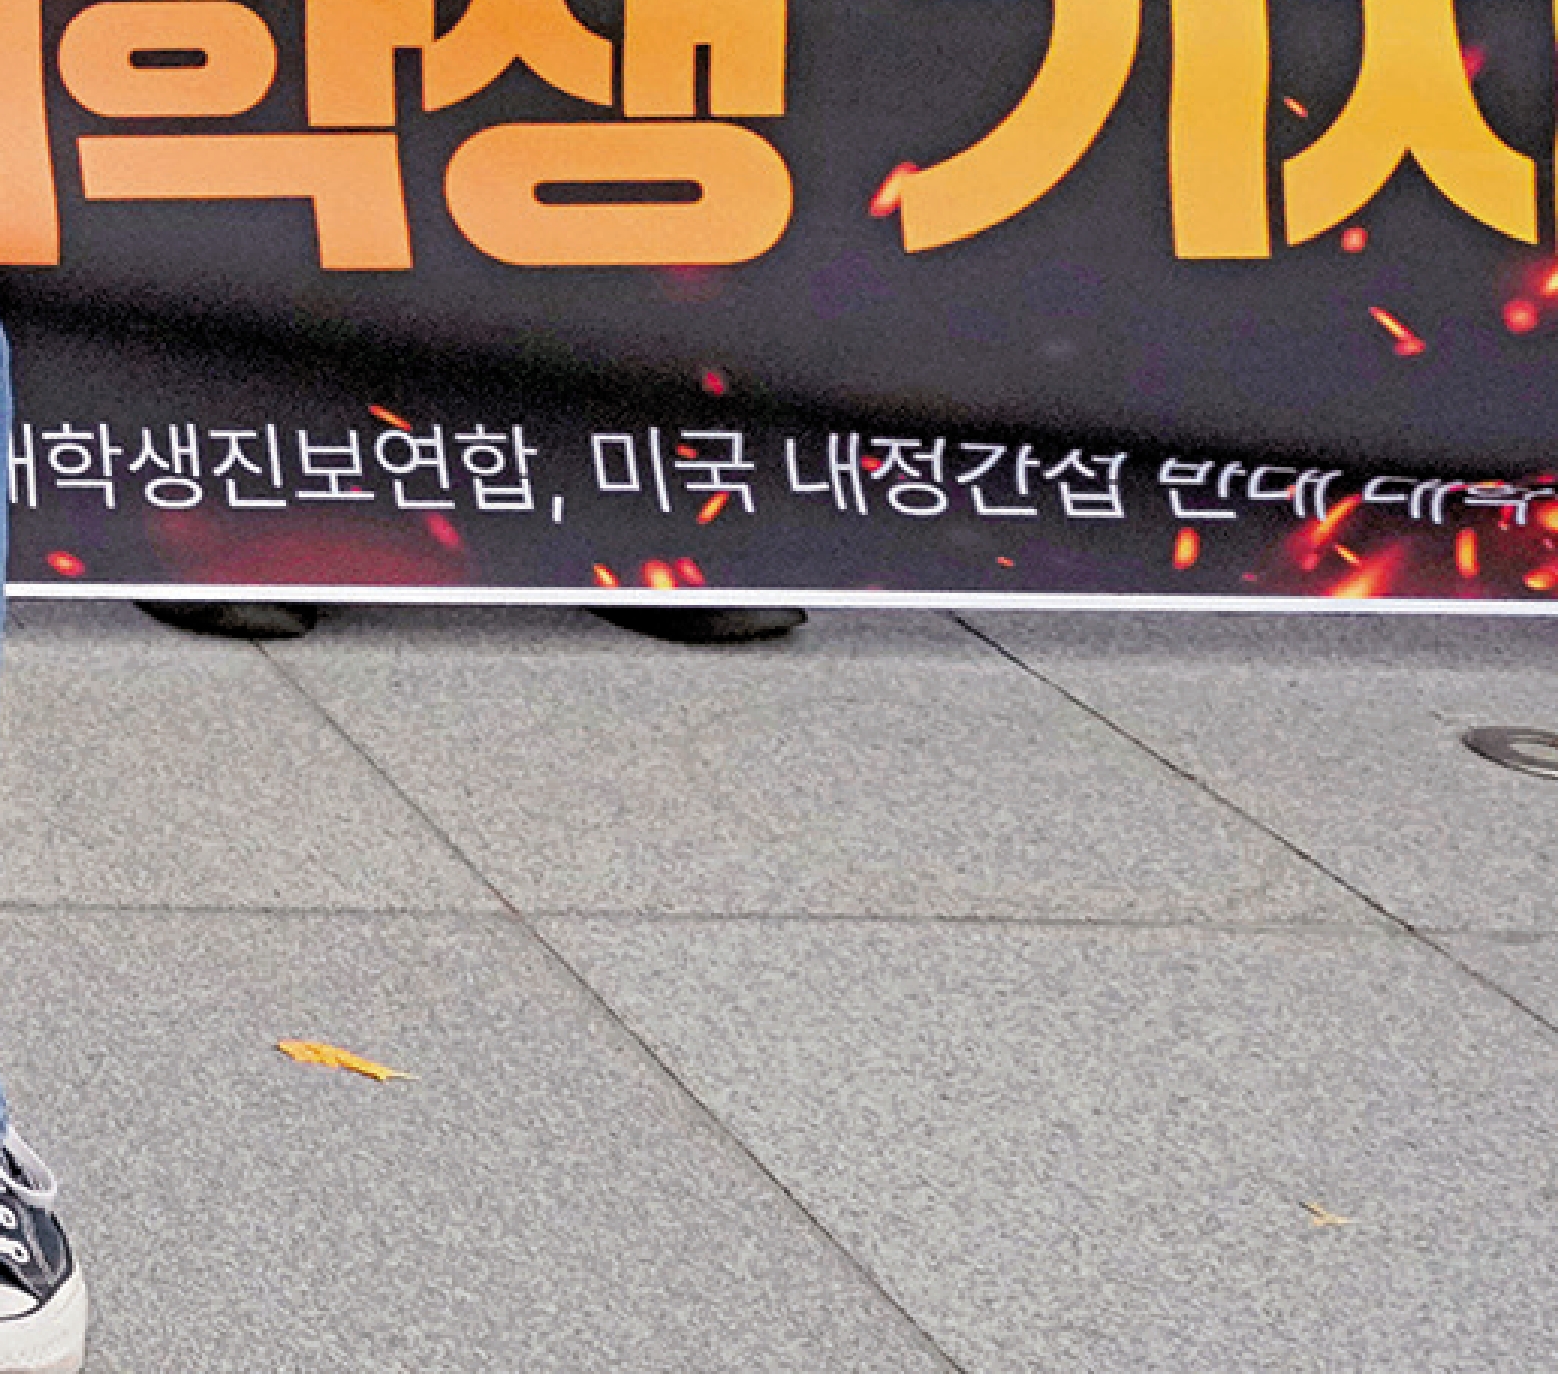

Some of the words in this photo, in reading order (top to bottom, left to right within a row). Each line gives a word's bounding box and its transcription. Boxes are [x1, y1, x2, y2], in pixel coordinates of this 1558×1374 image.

[591, 425, 755, 514] 미국
[786, 430, 1129, 519] 내정간섭
[1158, 456, 1344, 520] 반대
